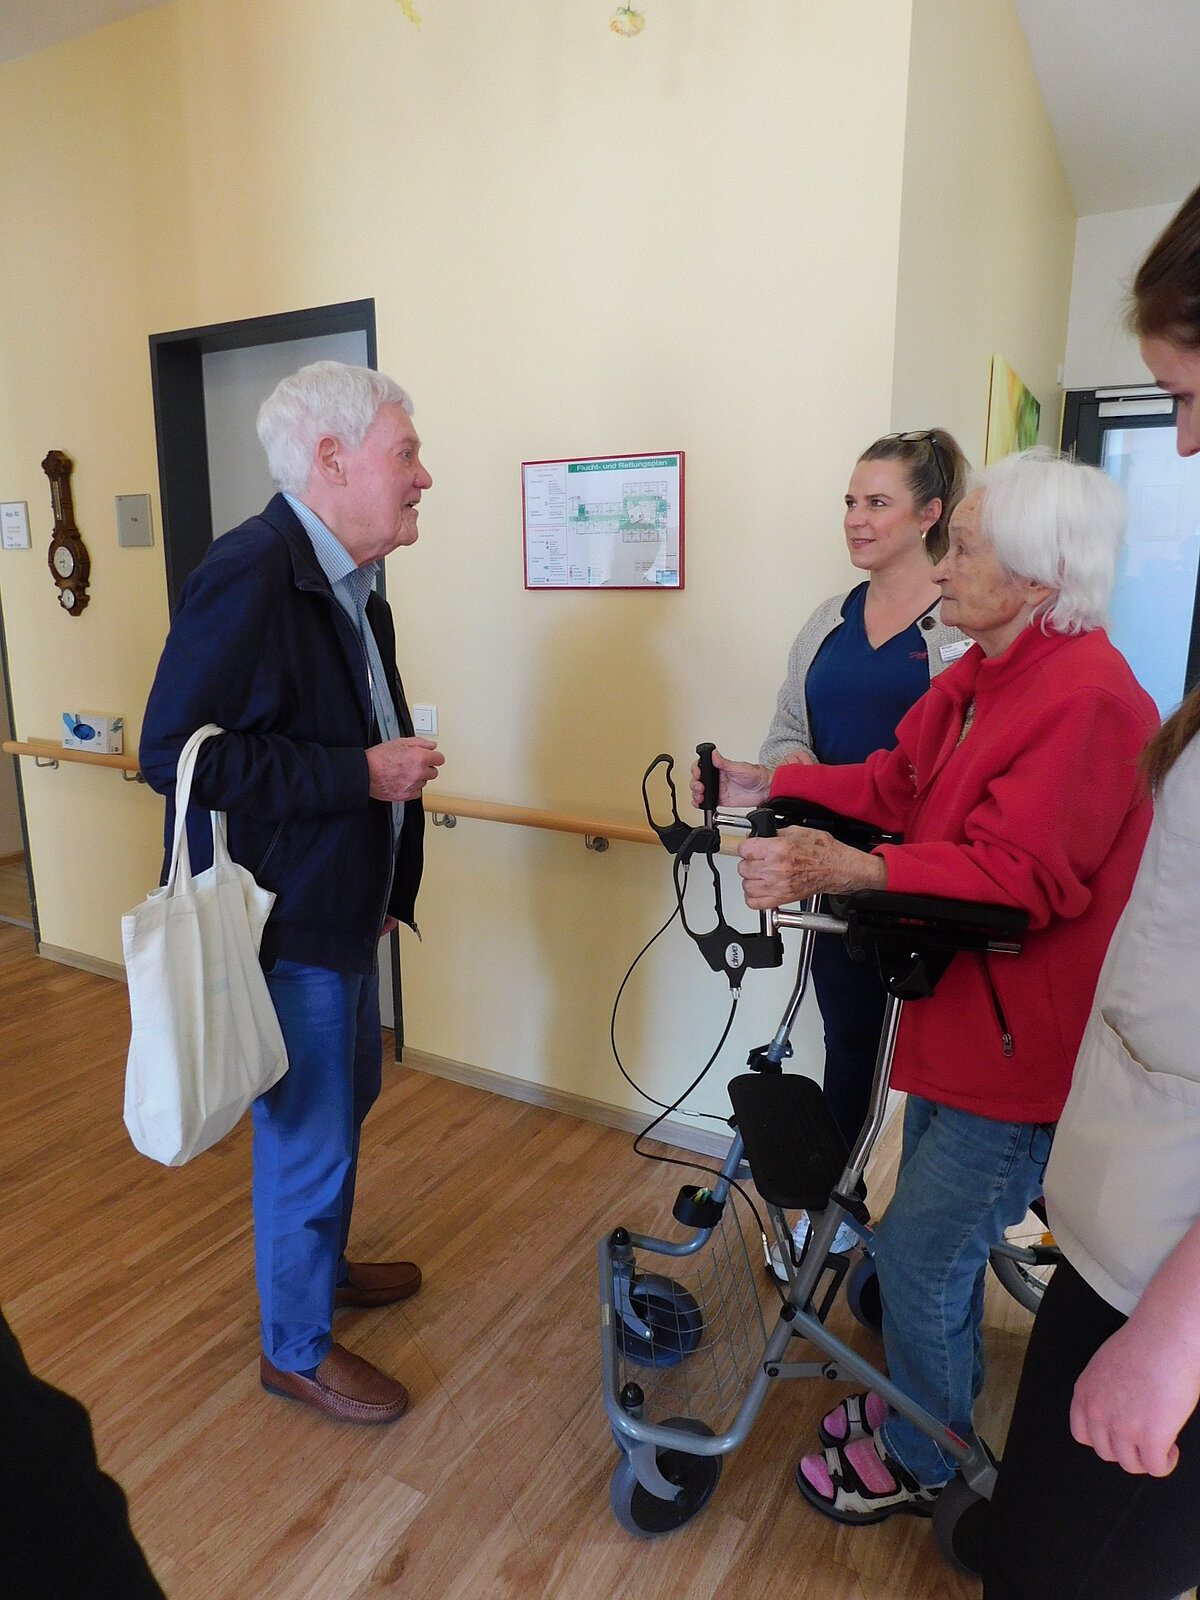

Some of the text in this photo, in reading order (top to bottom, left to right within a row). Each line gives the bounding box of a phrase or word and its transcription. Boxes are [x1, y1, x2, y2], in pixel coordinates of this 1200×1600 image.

[576, 459, 668, 472] Flucht- und Rettungsplan
[731, 945, 739, 967] drive
